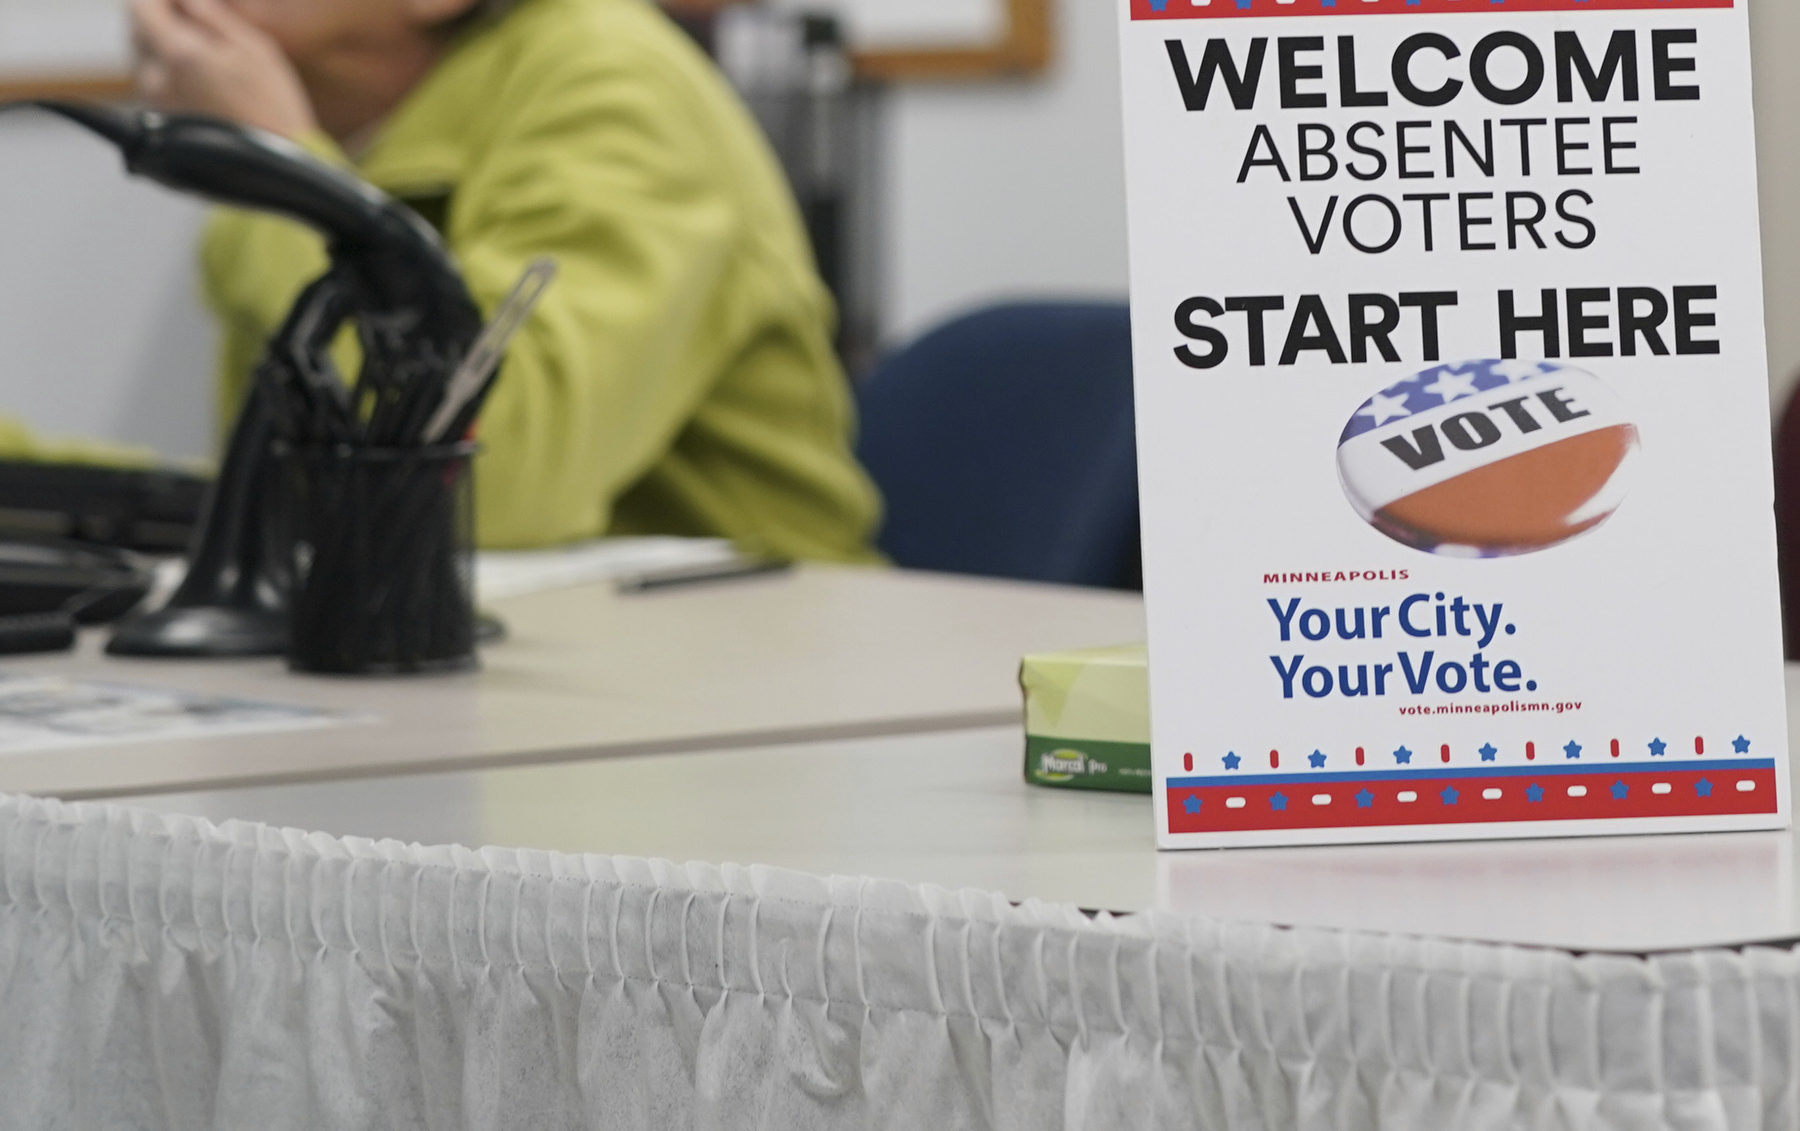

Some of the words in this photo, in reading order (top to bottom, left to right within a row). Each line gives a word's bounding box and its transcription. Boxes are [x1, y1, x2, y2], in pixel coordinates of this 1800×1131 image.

[1164, 27, 1702, 112] WELCOME
[1236, 116, 1641, 184] ABSENTEE
[1286, 188, 1597, 255] VOTERS
[1172, 290, 1459, 370] START
[1497, 284, 1722, 360] HERE
[1380, 386, 1592, 471] VOTE
[1262, 569, 1410, 584] MINNEAPOLIS
[1266, 597, 1391, 642] Your
[1398, 591, 1517, 649] City.
[1269, 654, 1394, 699] Your
[1396, 650, 1538, 695] Vote.
[1398, 700, 1583, 716] vote.minneapolismn.gov
